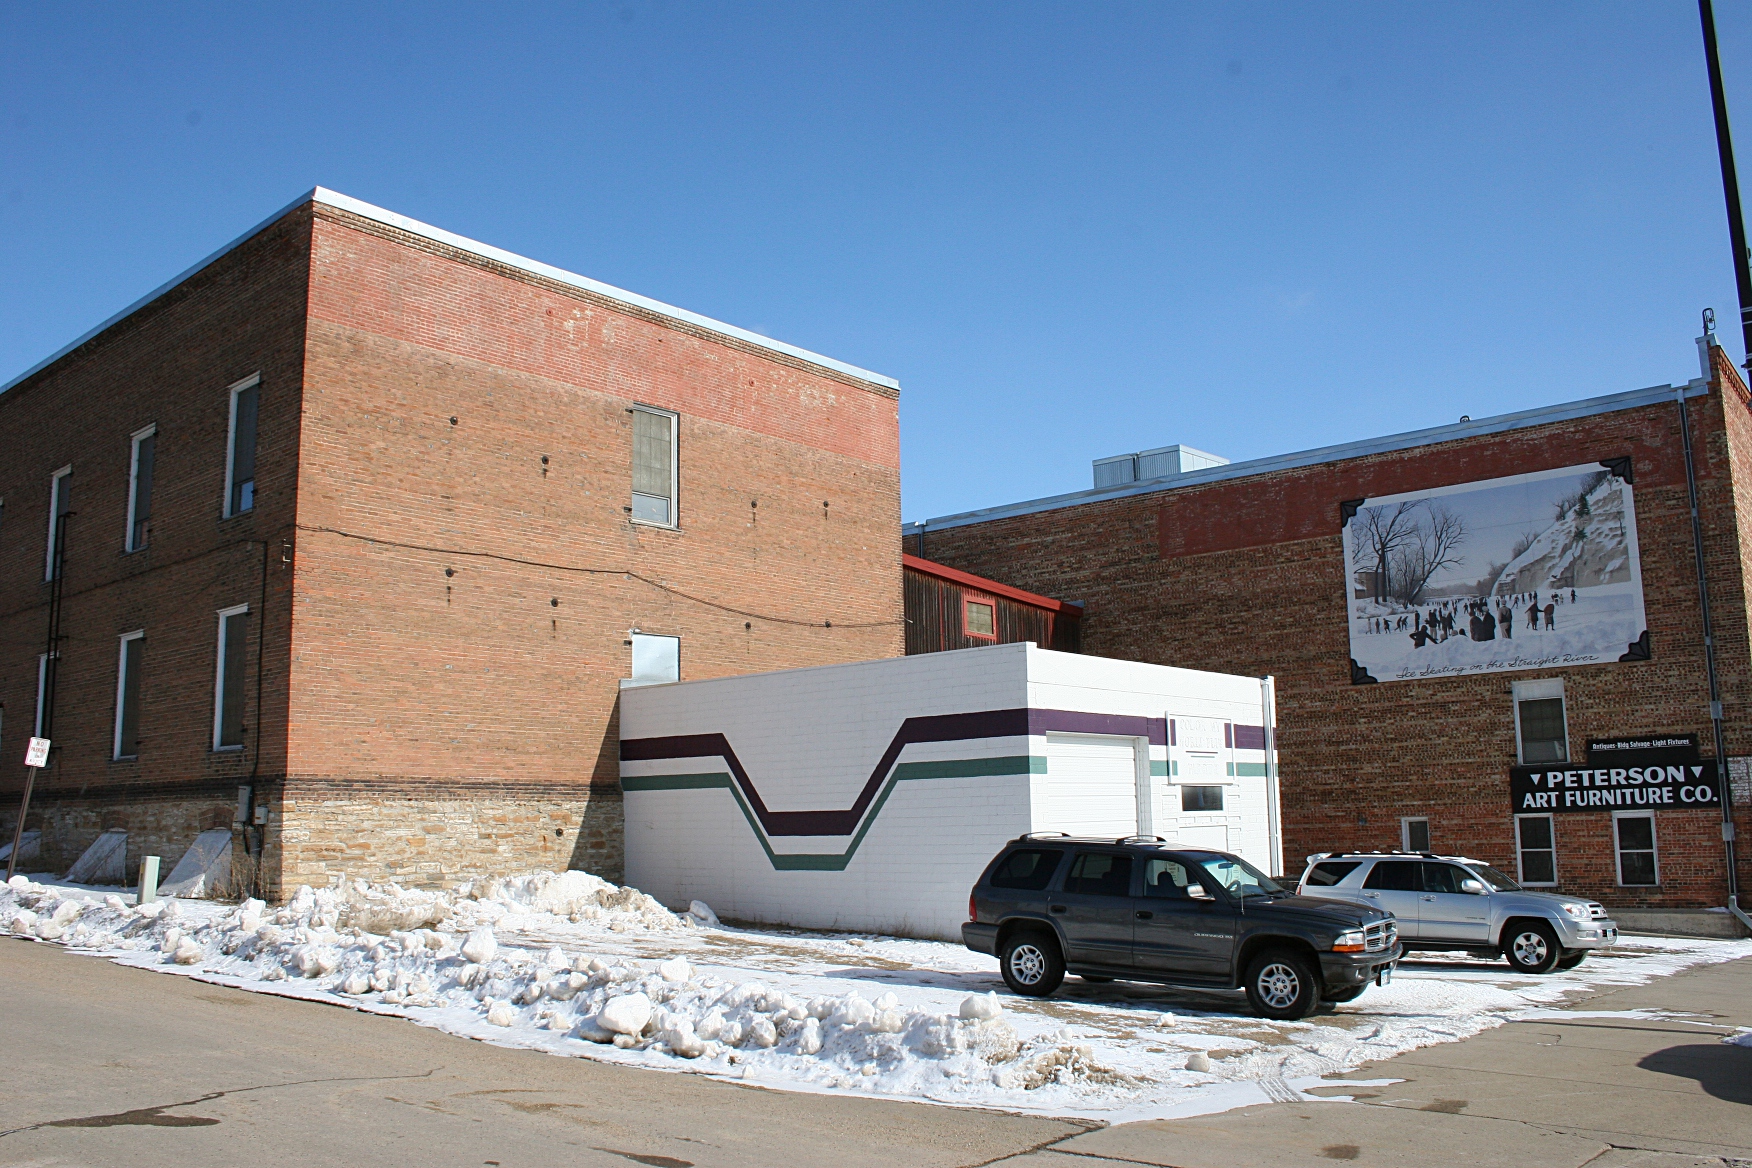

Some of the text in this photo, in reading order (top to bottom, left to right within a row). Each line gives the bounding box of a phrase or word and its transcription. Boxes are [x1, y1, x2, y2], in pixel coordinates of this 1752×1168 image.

[1396, 667, 1416, 678] Ice
[1420, 664, 1466, 676] Skating
[1486, 660, 1505, 670] the
[1508, 656, 1560, 668] Straight
[1563, 653, 1600, 663] River
[1546, 765, 1686, 788] PETERSON
[1522, 785, 1718, 808] ART FURNITURE CO.
